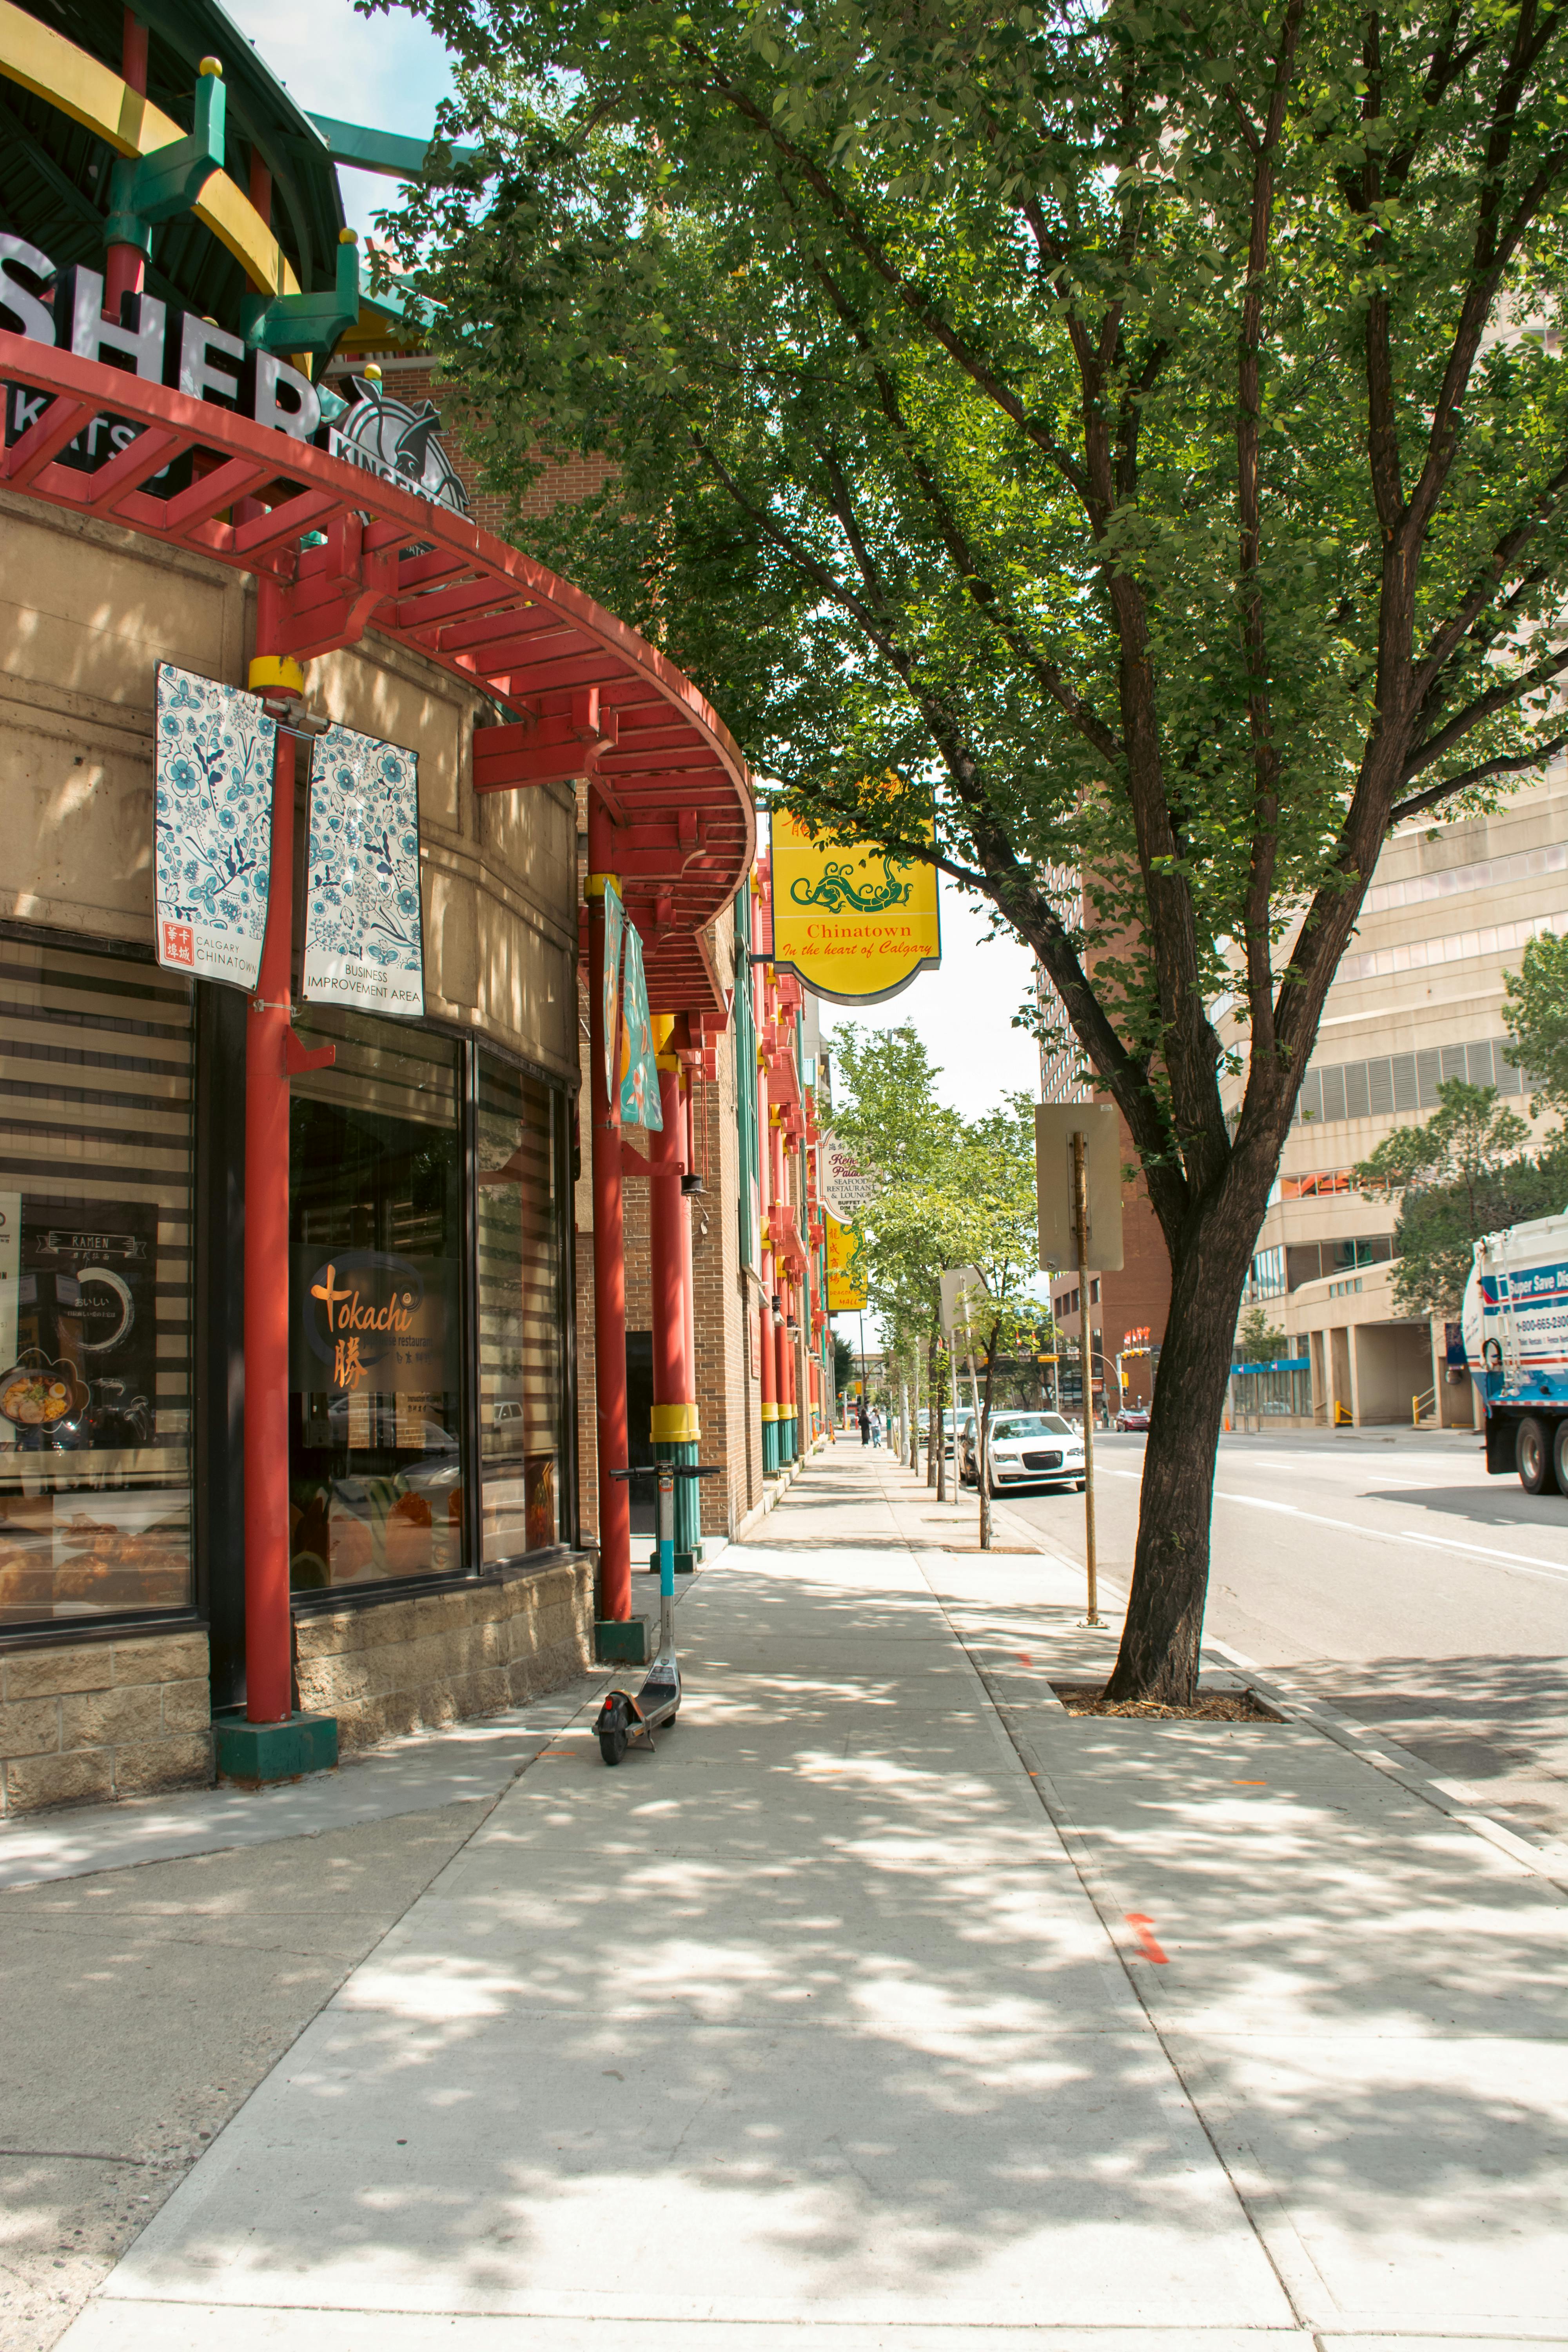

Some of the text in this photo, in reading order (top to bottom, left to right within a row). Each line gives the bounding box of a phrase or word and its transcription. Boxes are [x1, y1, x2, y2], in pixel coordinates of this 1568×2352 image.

[807, 924, 911, 938] Chinatown
[196, 936, 239, 953] CALGARY
[783, 940, 933, 958] In the heart of Calgary
[197, 949, 257, 974] CHINATOWN
[345, 964, 388, 982] BUSINESS
[308, 976, 421, 1002] IMPROVEMENT AREA
[73, 1236, 109, 1249] RAMEN
[1509, 1279, 1532, 1299] Super
[1534, 1275, 1555, 1291] Save
[75, 1297, 109, 1307] おいしい
[334, 1336, 368, 1390] 勝
